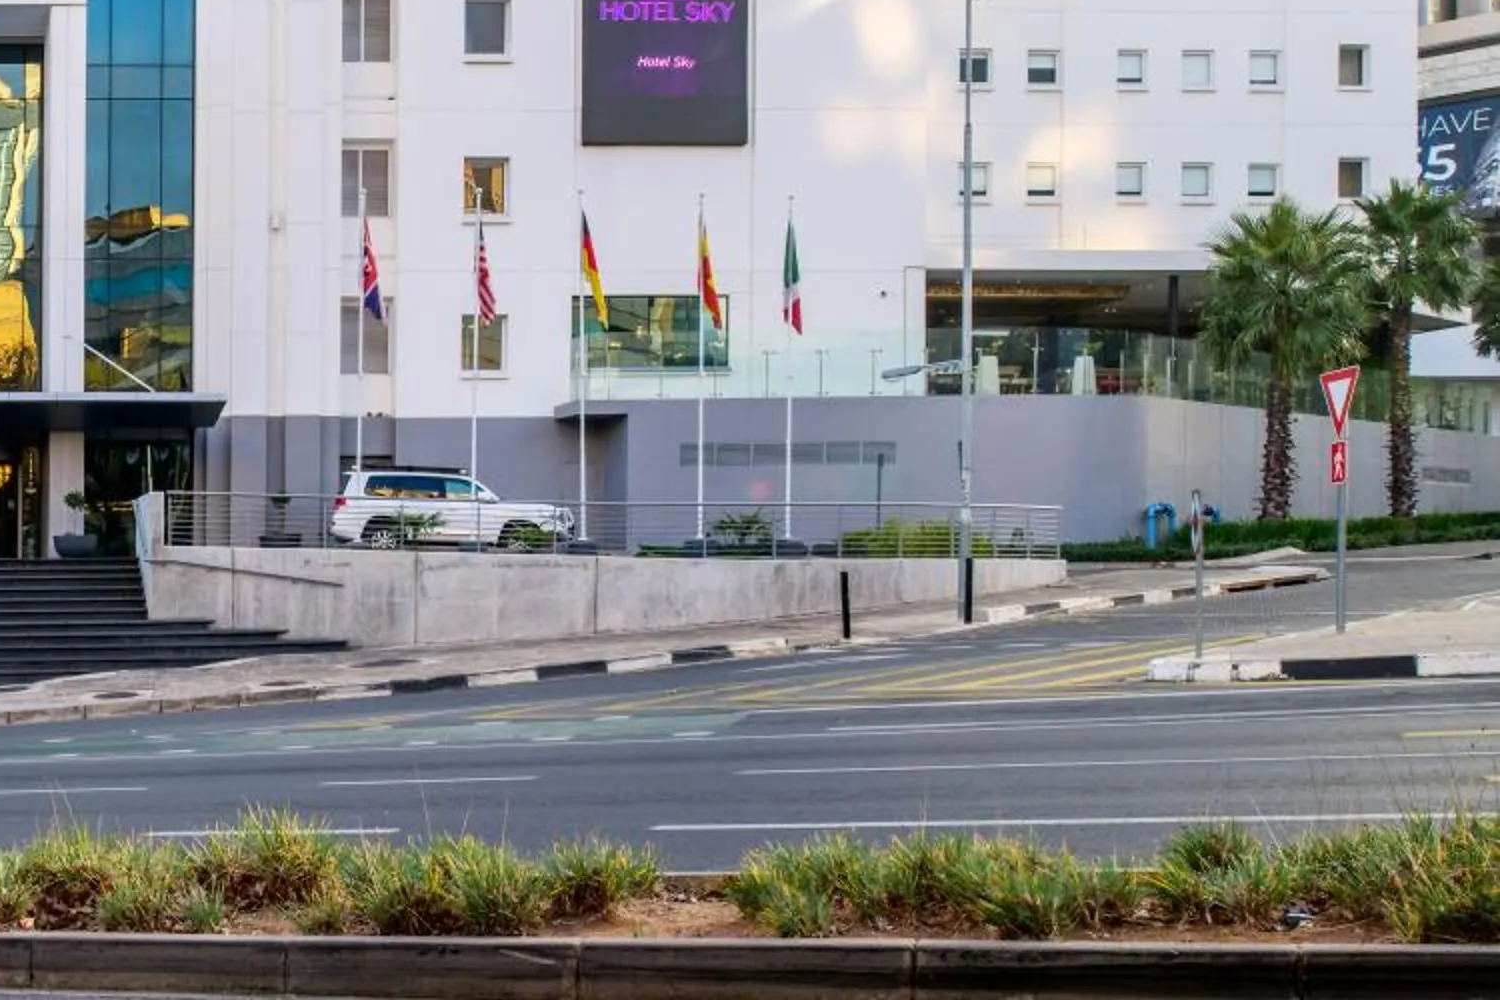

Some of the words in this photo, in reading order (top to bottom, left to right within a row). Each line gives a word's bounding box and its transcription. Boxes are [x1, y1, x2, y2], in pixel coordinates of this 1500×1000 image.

[599, 0, 681, 22] HOTEL
[684, 0, 736, 23] SKY
[636, 55, 671, 69] Hotel
[673, 55, 696, 70] Sky
